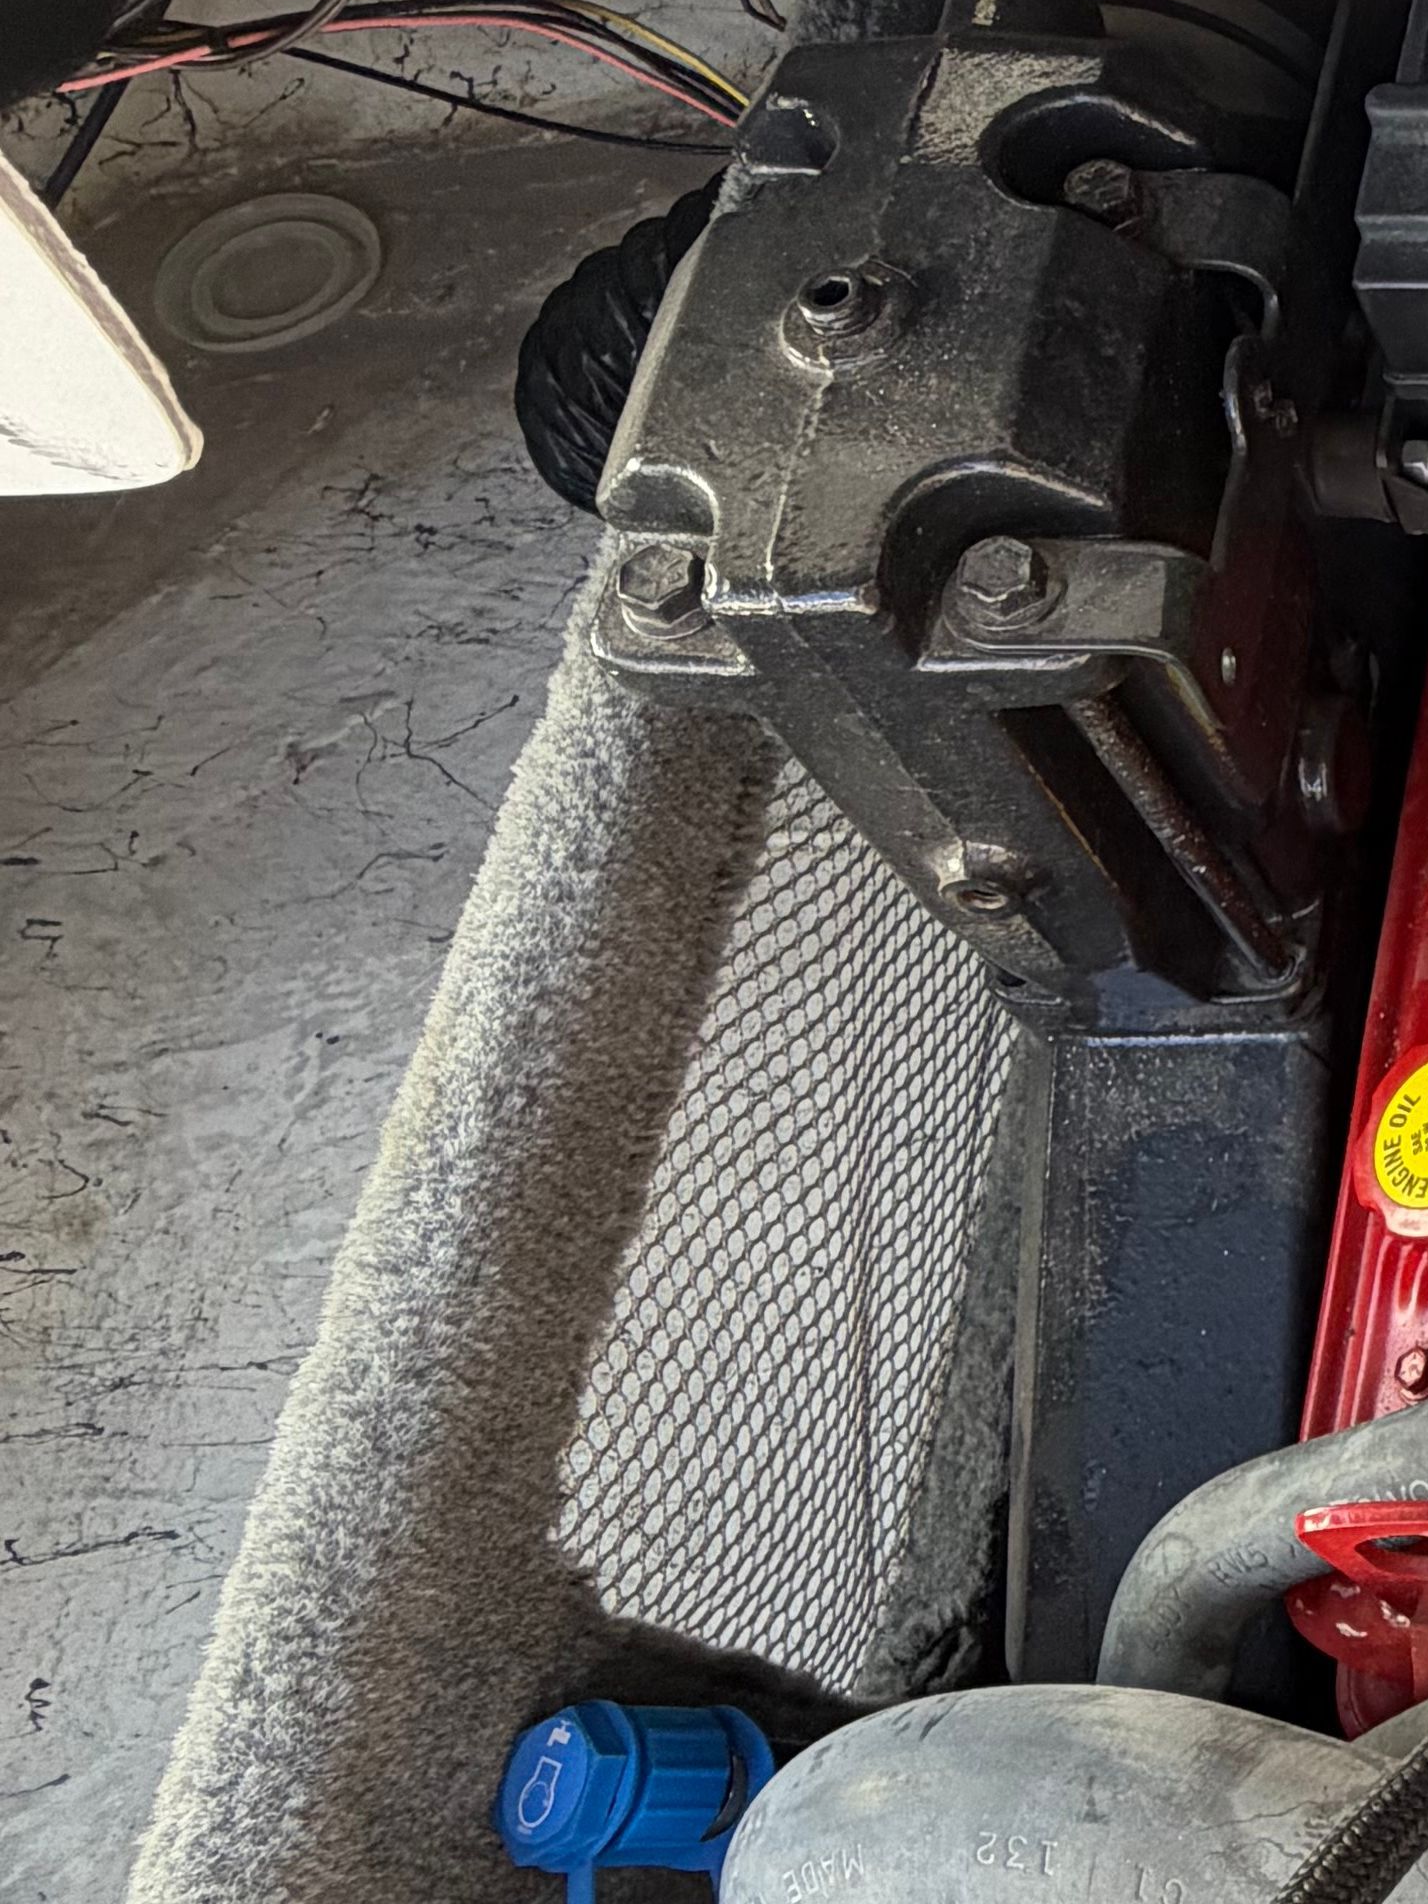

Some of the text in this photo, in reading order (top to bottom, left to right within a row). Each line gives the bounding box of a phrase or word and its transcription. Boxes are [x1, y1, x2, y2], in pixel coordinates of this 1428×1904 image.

[1389, 1093, 1421, 1129] OIL
[1410, 1129, 1424, 1155] SAE
[976, 1831, 1059, 1875] 132
